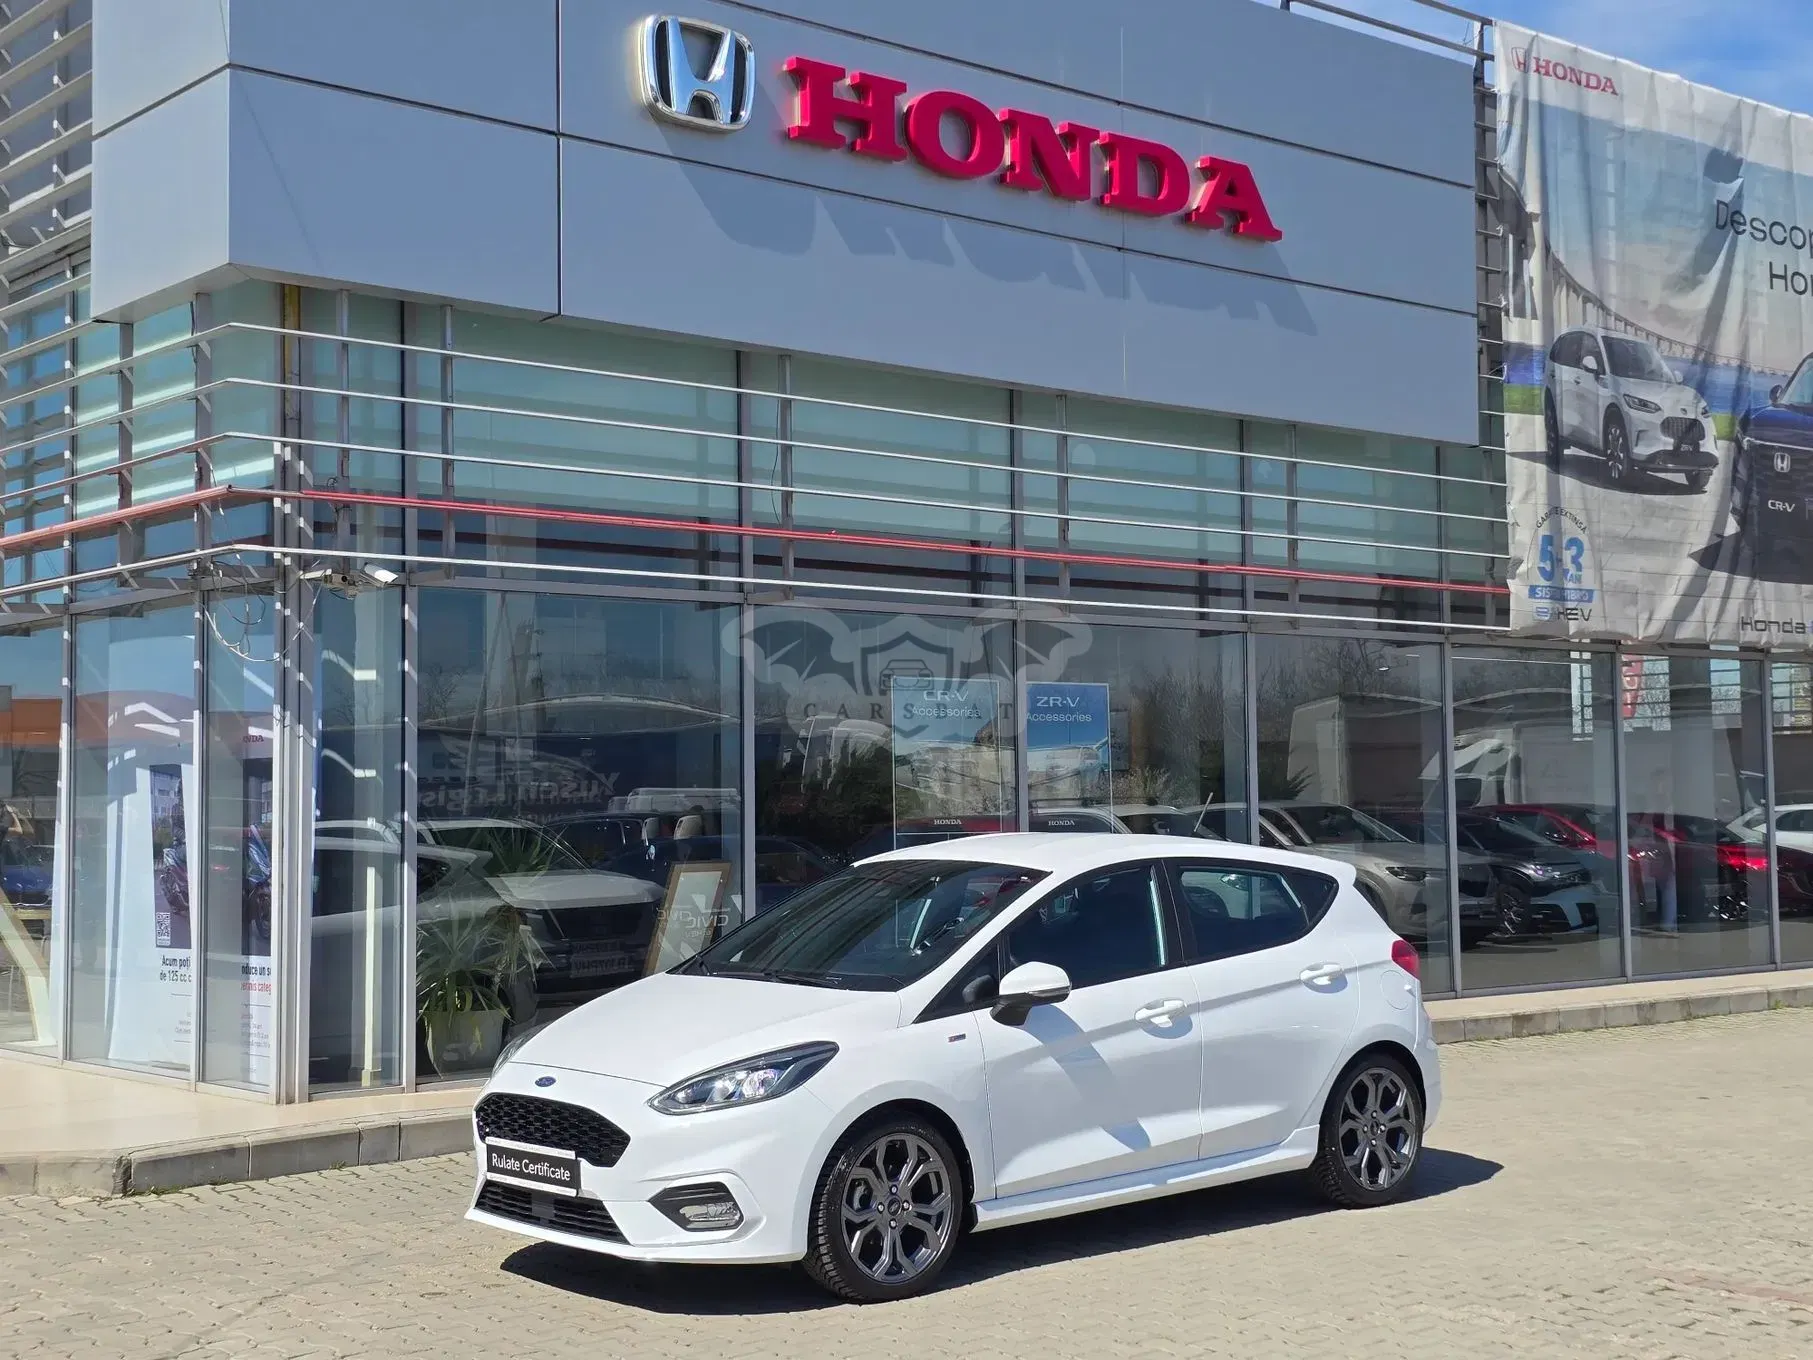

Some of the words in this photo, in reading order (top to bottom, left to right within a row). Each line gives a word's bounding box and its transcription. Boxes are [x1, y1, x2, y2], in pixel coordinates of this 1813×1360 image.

[1533, 56, 1619, 96] HONDA
[784, 56, 1283, 241] HONDA
[1767, 499, 1795, 512] CR-V
[1741, 615, 1806, 635] Honda
[923, 690, 969, 702] CR-V
[1036, 696, 1080, 707] ZR-V
[912, 706, 981, 718] Accessories
[1027, 711, 1092, 722] Accessories
[162, 955, 178, 967] Acum
[160, 970, 167, 981] de
[168, 970, 178, 982] 125
[492, 1153, 520, 1171] Rulate
[522, 1159, 571, 1181] Certificate
